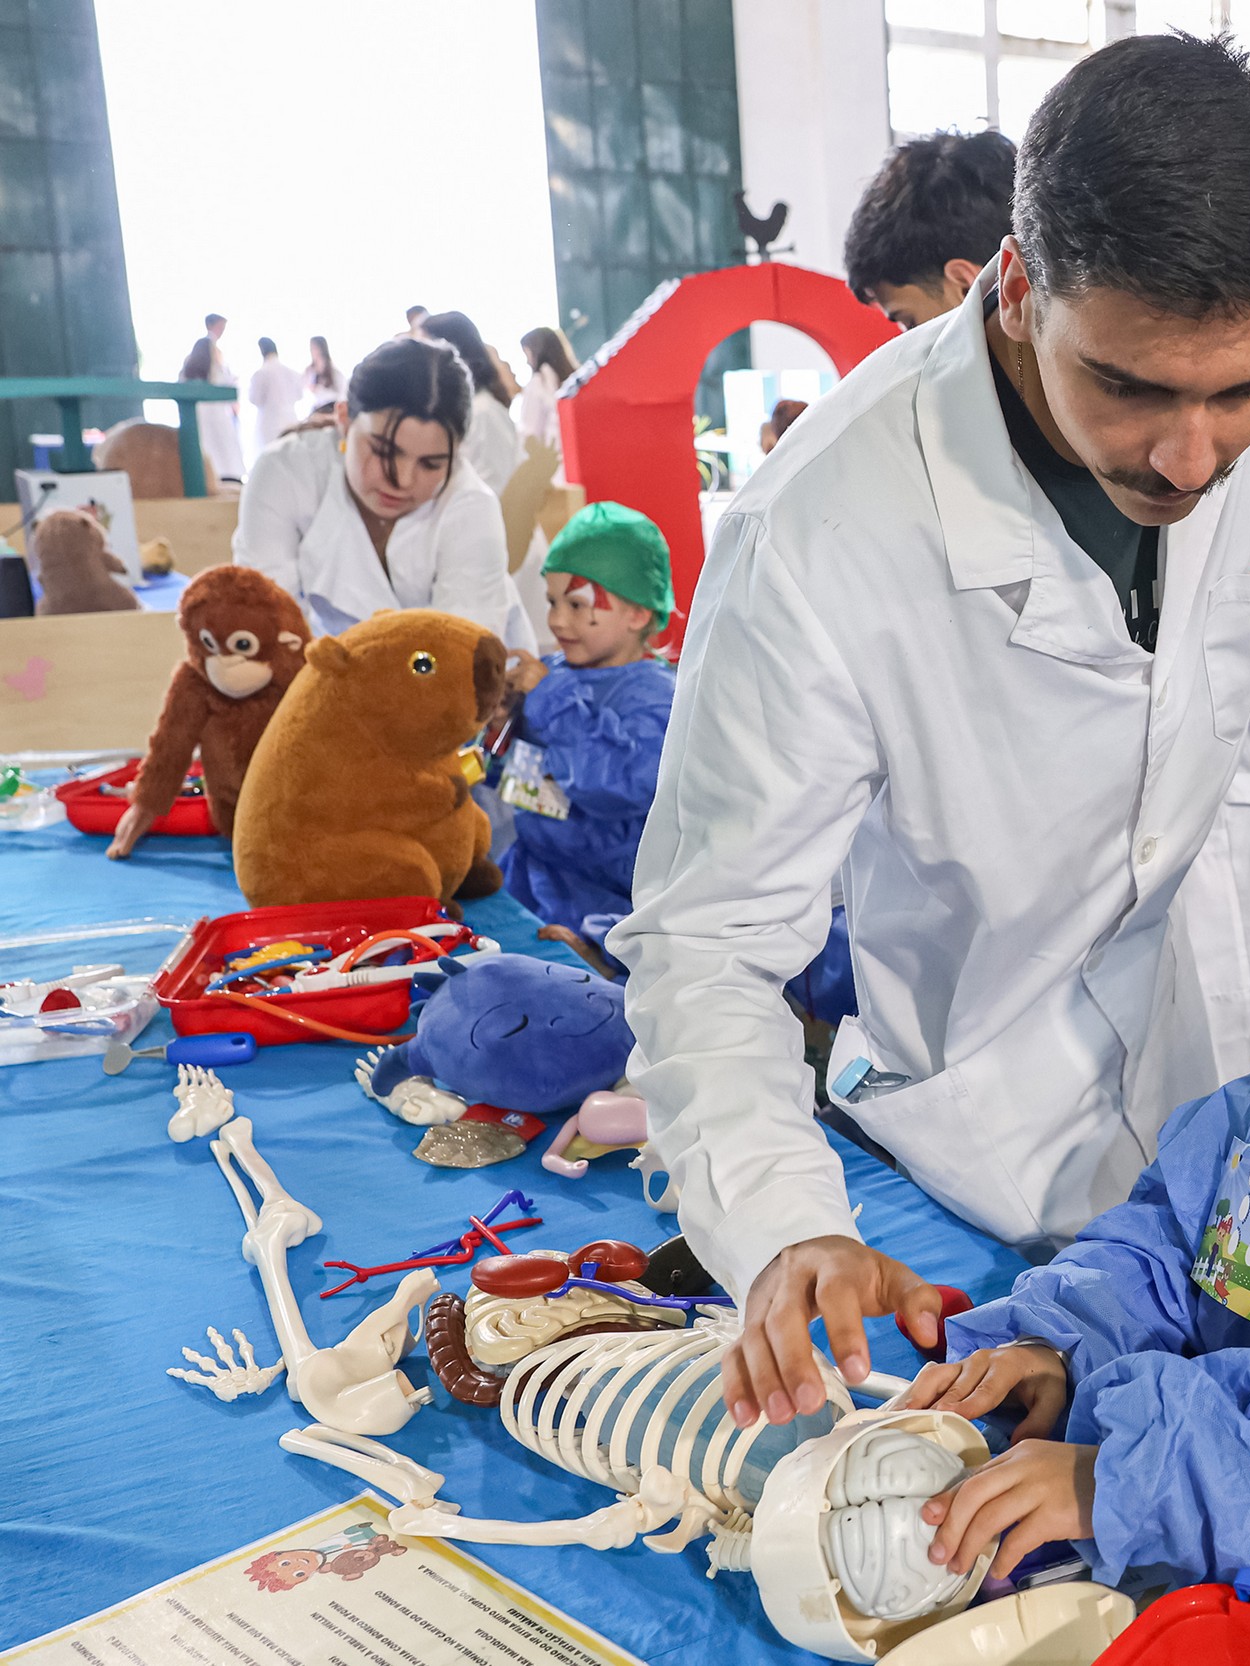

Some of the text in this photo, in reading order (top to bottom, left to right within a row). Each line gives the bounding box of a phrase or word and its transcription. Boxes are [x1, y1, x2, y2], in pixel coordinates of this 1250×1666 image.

[371, 1589, 402, 1609] BONECO
[395, 1605, 412, 1616] TEU
[407, 1613, 422, 1622] DO
[486, 1609, 512, 1625] MUITO
[505, 1607, 539, 1628] ANÁLISES
[354, 1619, 385, 1639] BONECO
[416, 1619, 447, 1639] CARTÃO
[506, 1622, 533, 1638] ESTEJA
[472, 1627, 520, 1659] IMAGIOLOGIA
[526, 1636, 542, 1645] HP
[537, 1642, 553, 1651] DO
[542, 1631, 577, 1652] ESTAÇÃO
[396, 1649, 421, 1665] PASSA
[451, 1642, 489, 1666] CONSULTA
